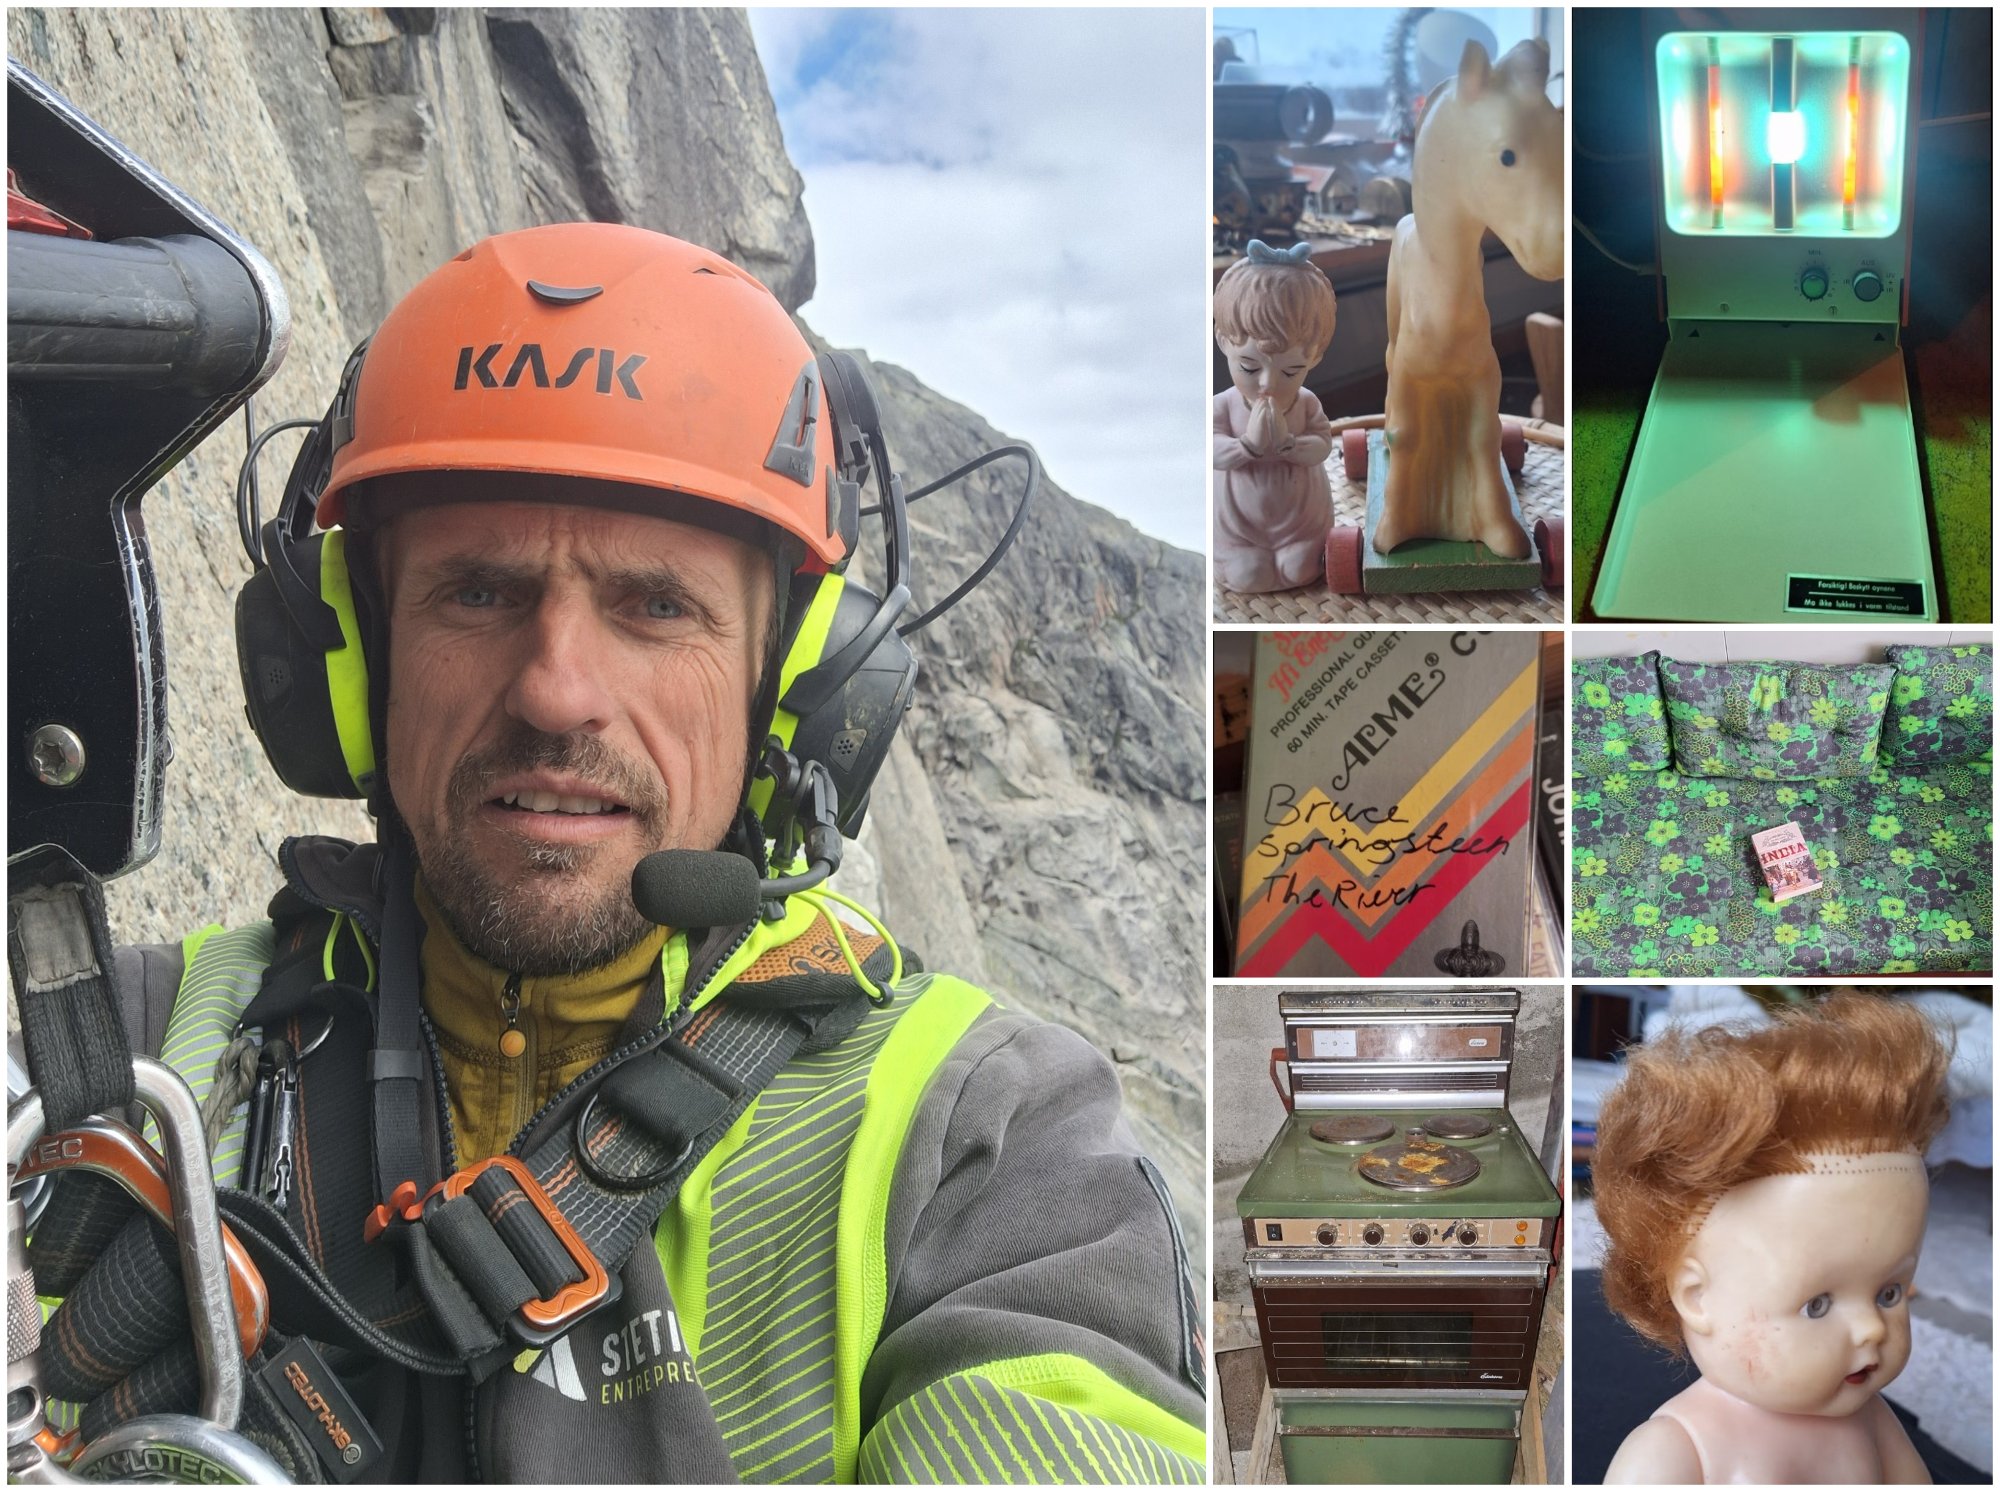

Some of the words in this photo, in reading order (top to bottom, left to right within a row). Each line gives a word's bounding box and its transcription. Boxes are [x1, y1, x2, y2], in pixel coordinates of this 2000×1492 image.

[454, 344, 648, 401] KASK
[1818, 599, 1833, 607] ikke
[1835, 599, 1856, 608] lukkes
[1270, 651, 1355, 738] PROFESSIONAL
[1286, 736, 1303, 754] 60
[1299, 712, 1329, 740] MIN.
[1324, 678, 1358, 711] TAPE
[1264, 783, 1409, 827] Bruce
[1257, 822, 1510, 868] Springsteen
[1761, 842, 1807, 864] INDIA
[1263, 872, 1323, 908] The
[601, 1361, 695, 1405] ENTREPRE
[284, 1361, 352, 1450] SKYLOTEC
[82, 1448, 222, 1485] SKYLOTEC
